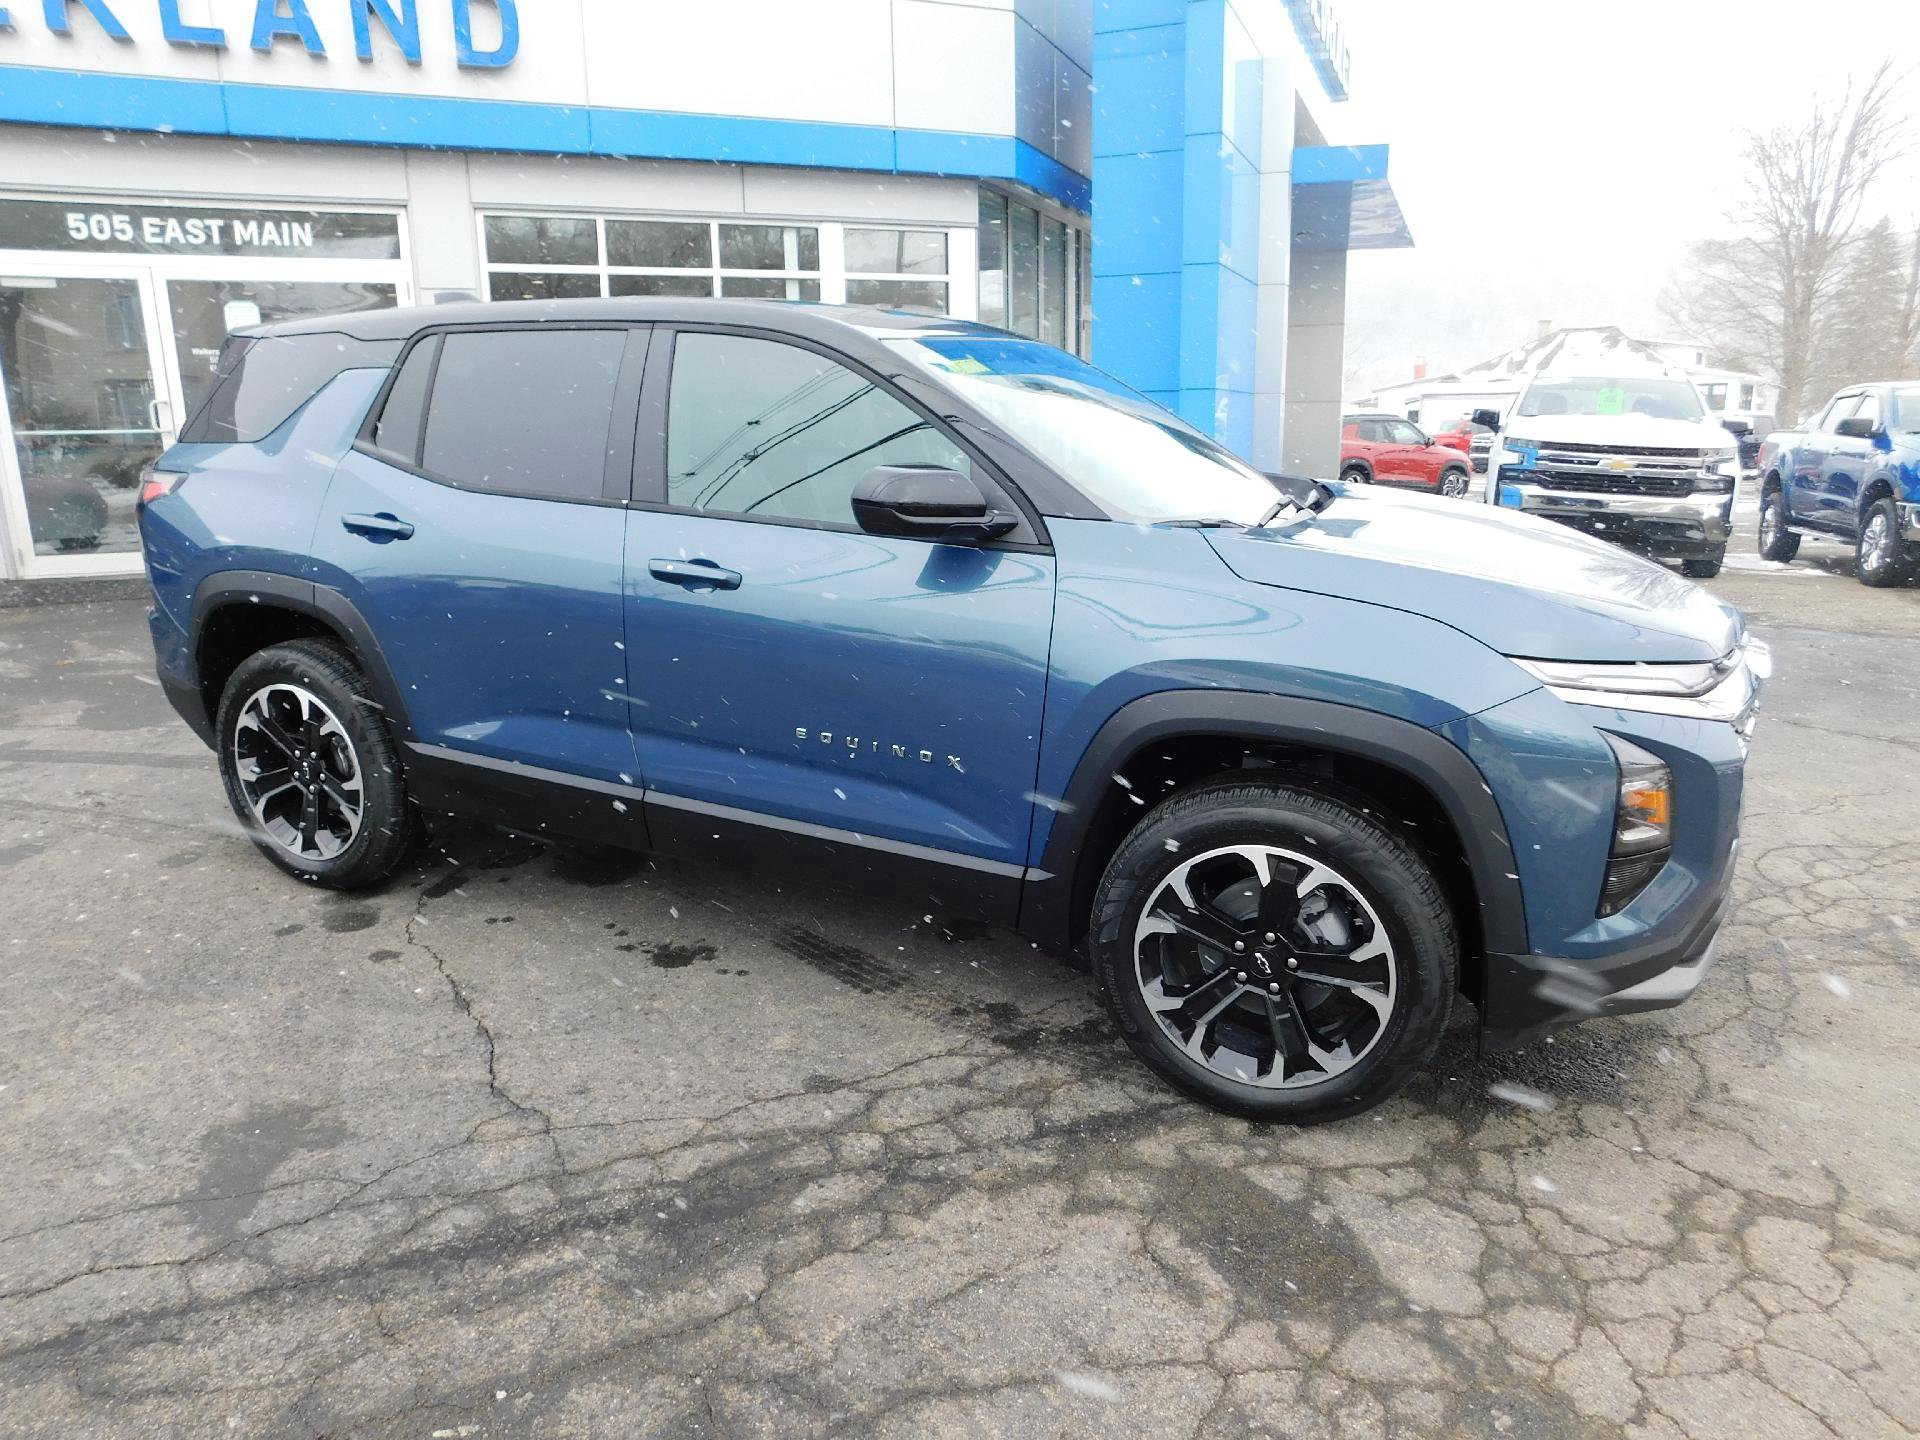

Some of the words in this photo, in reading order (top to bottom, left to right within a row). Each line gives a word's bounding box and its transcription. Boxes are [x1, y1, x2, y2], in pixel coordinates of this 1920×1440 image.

[0, 0, 519, 70] LAND
[66, 212, 134, 242] 505
[142, 217, 224, 245] EAST
[232, 220, 314, 247] MAIN
[795, 727, 965, 774] EQUINOX
